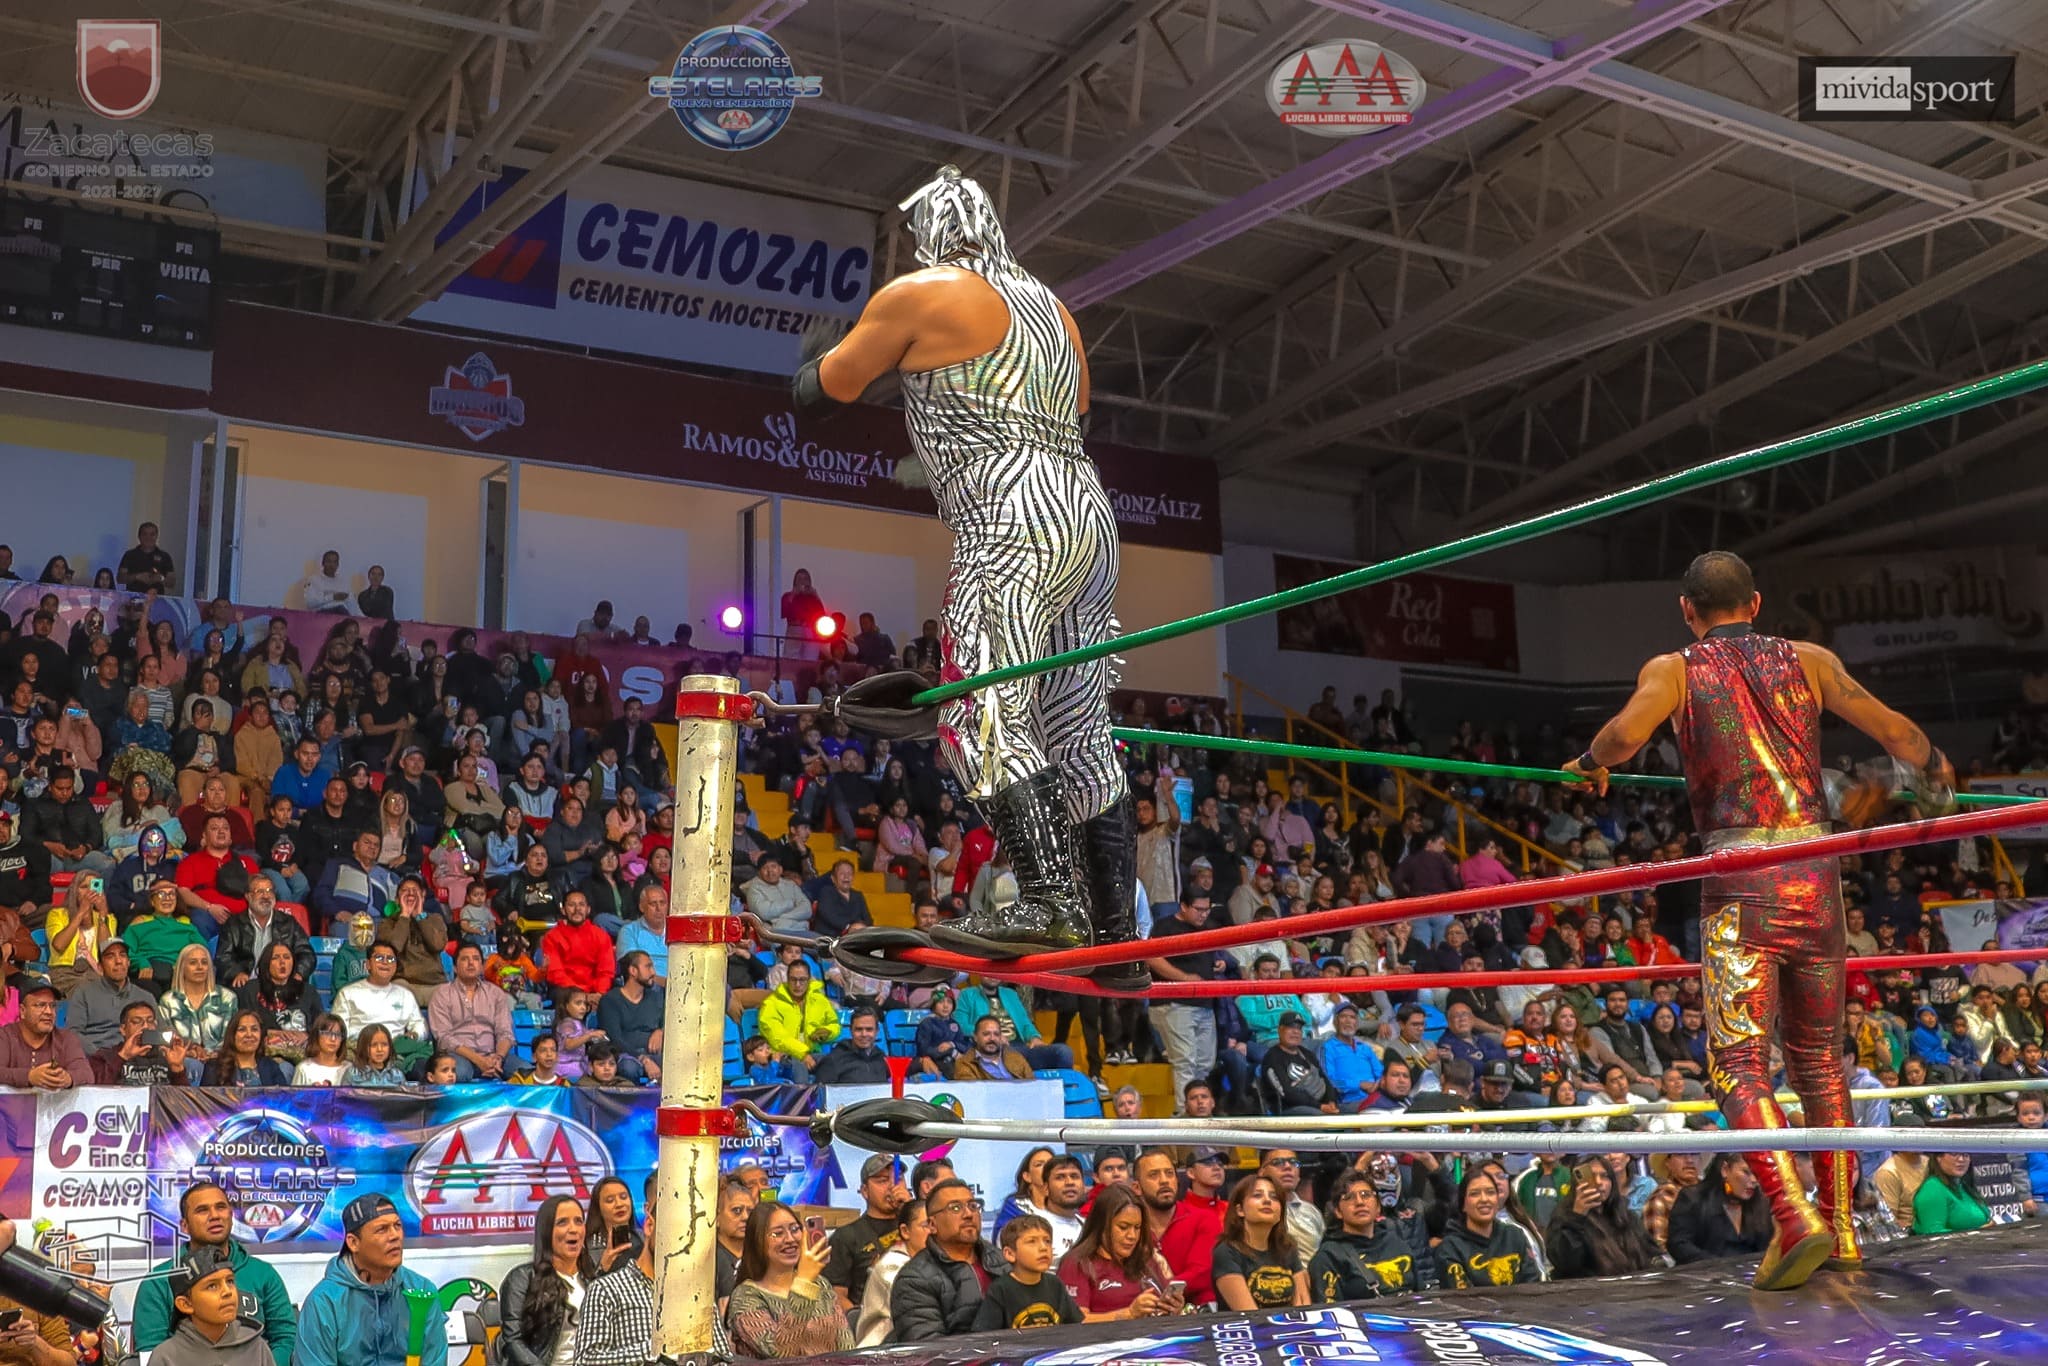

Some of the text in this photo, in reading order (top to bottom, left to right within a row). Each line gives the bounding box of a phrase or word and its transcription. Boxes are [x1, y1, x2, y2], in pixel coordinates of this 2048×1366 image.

[577, 203, 869, 304] CEMOZAC
[160, 262, 211, 284] VISITA
[569, 277, 704, 319] CEMENTOS
[805, 468, 868, 488] ASESORES
[1115, 511, 1156, 525] SESORES
[1387, 582, 1442, 623] Red
[1402, 623, 1441, 648] Cola
[1873, 630, 1958, 647] GRUPO
[204, 1142, 325, 1157] PRODUCCIONES
[421, 1111, 591, 1204] AAA
[174, 1165, 357, 1190] ESTELARES
[432, 1217, 474, 1231] LUCHA
[477, 1216, 515, 1229] LIBRE
